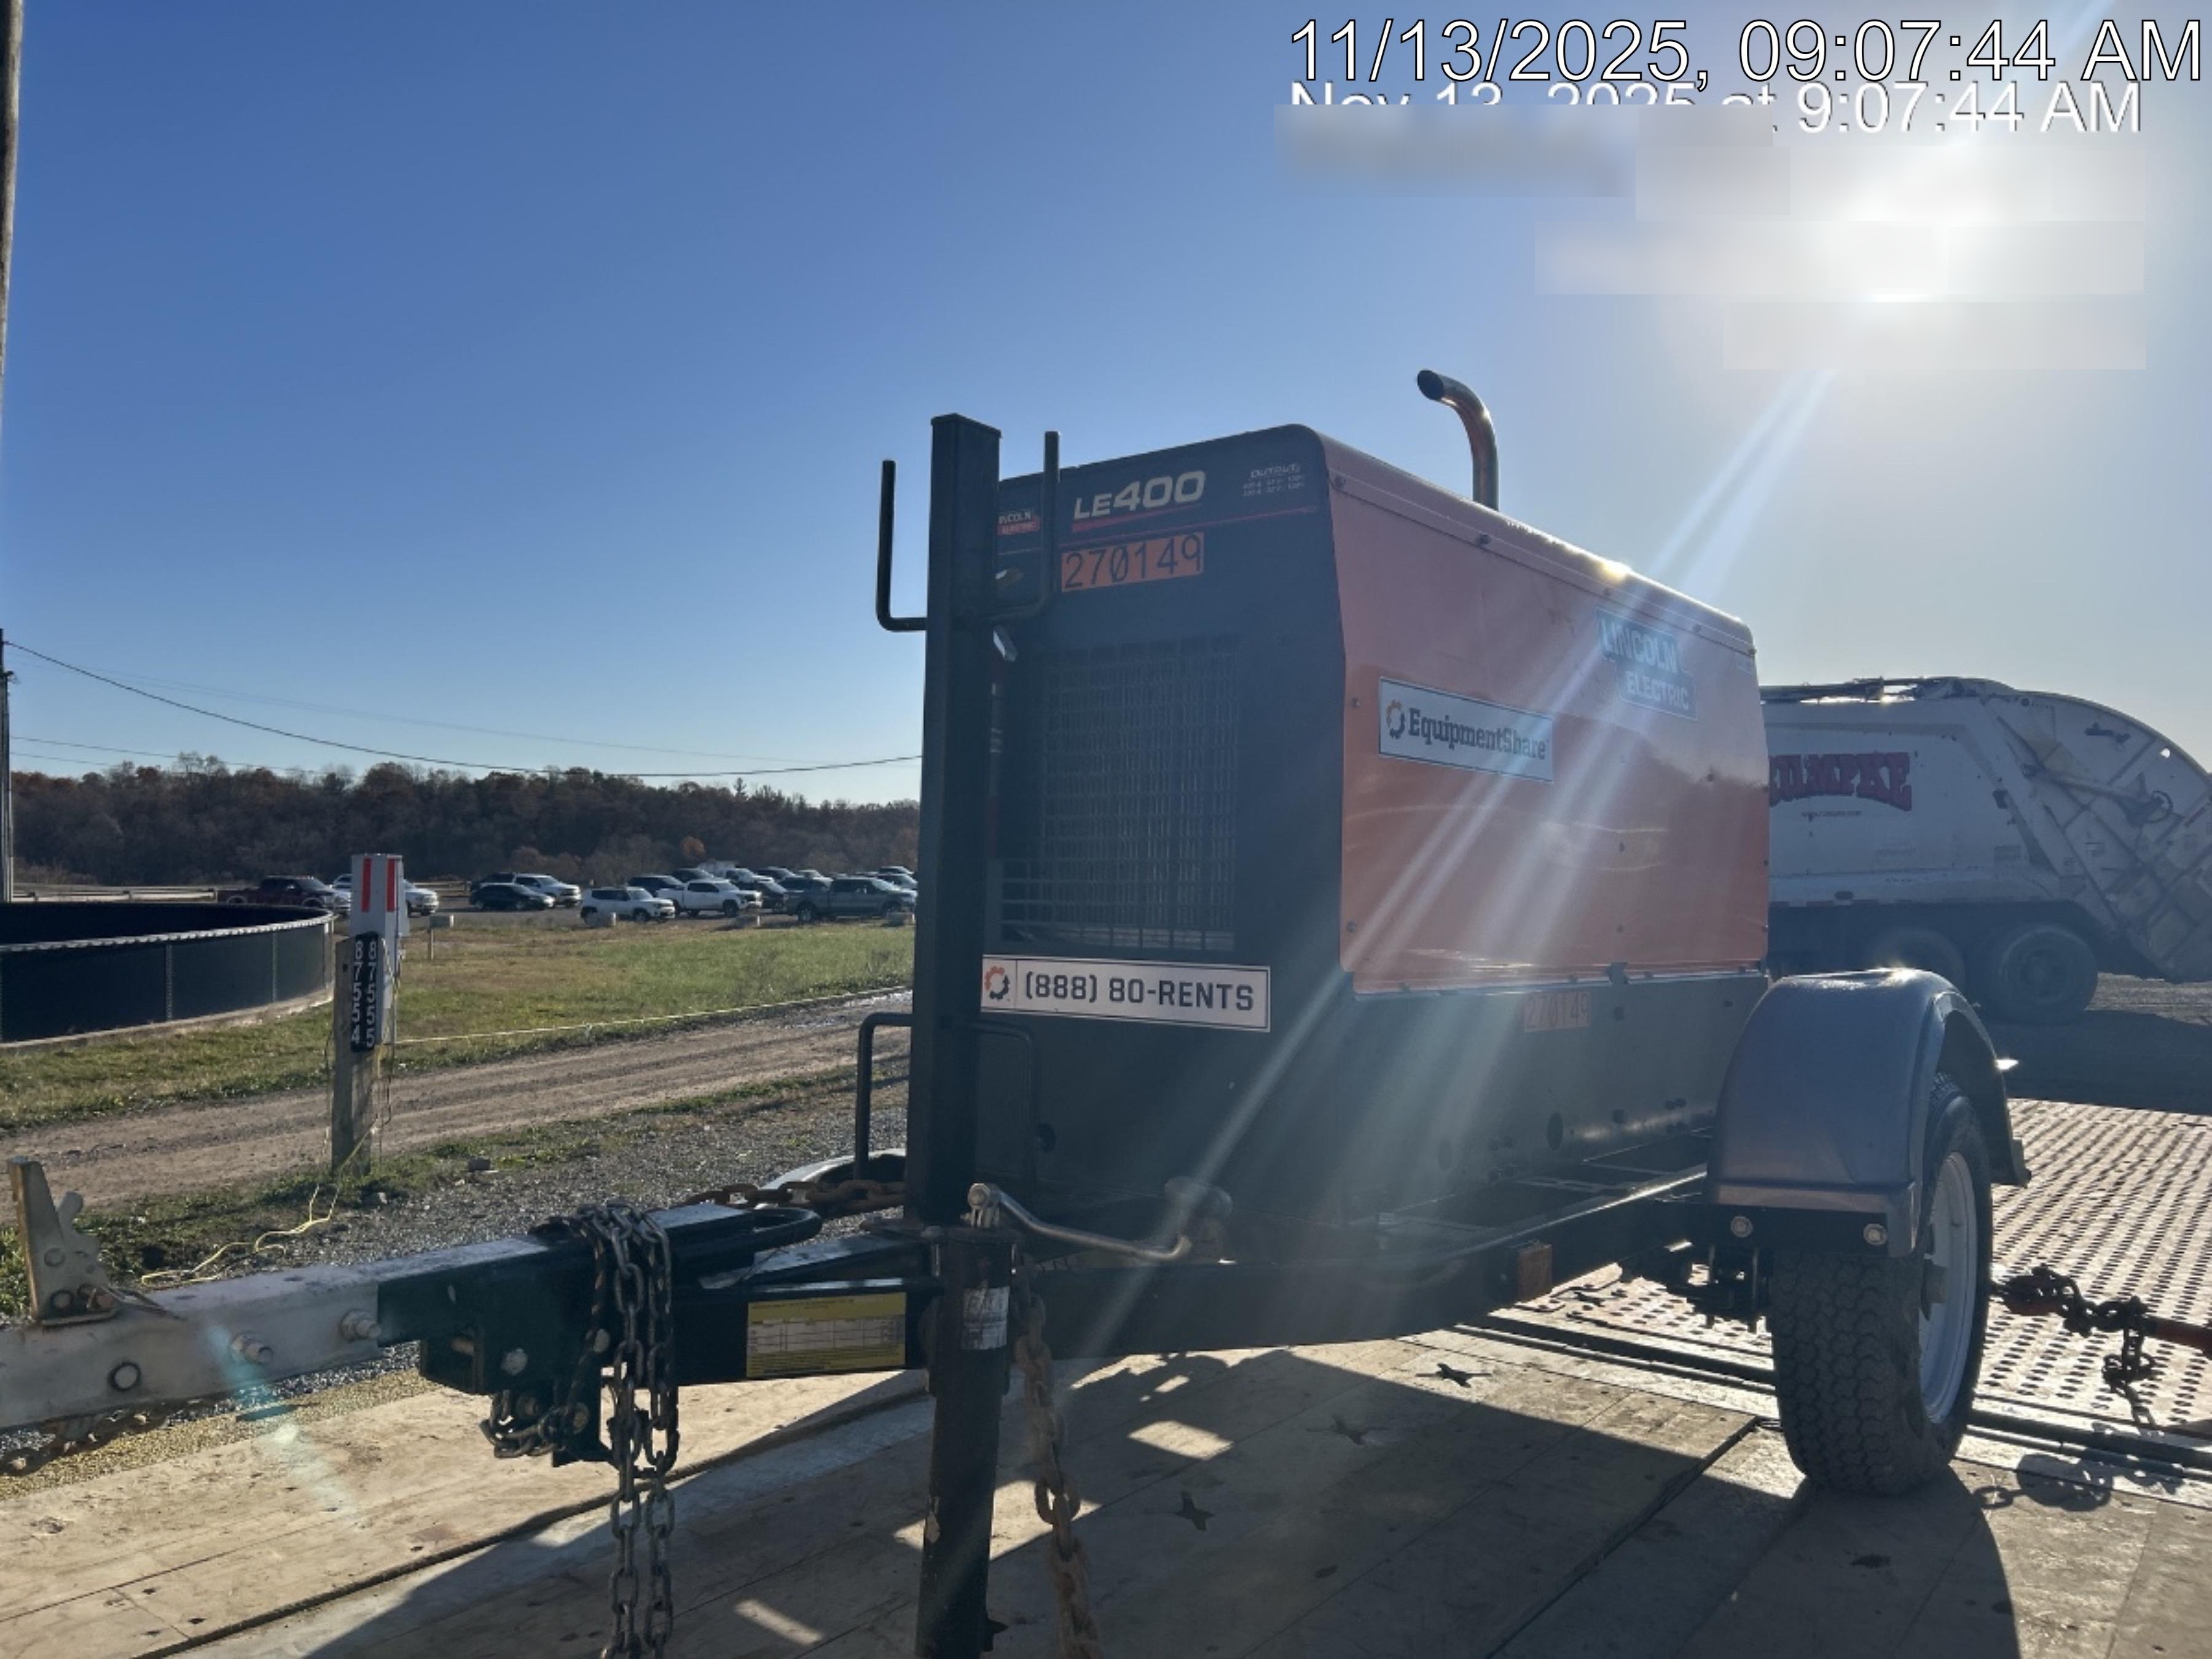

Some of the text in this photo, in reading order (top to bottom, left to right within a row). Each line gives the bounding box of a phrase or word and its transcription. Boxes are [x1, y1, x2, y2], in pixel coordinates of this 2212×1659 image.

[1073, 471, 1206, 520] LE400
[1064, 534, 1202, 589] 270149
[1601, 619, 1678, 673] LINCOLN
[1625, 670, 1690, 710] ELECTRIC
[1408, 707, 1546, 760] EquipmentShare
[1026, 971, 1255, 1011] (888) 80-RENTS
